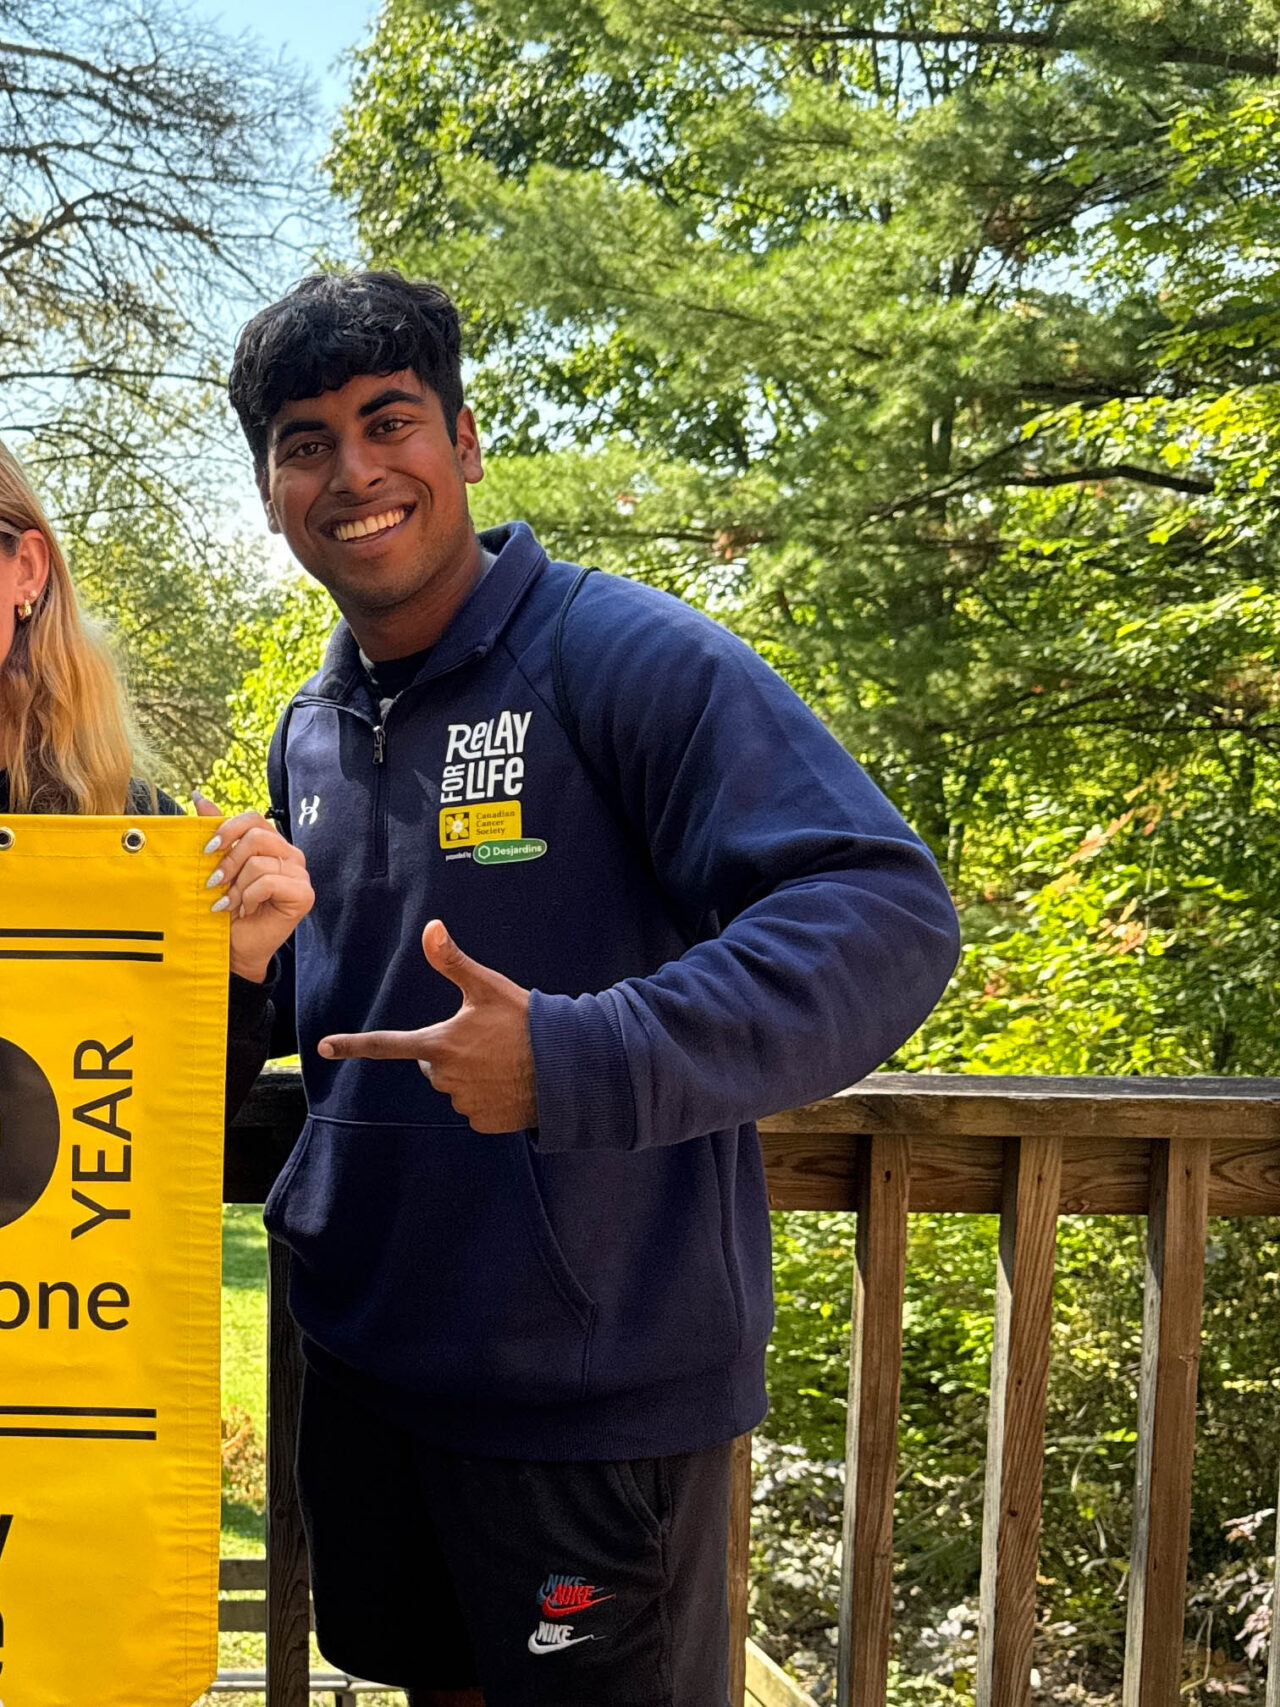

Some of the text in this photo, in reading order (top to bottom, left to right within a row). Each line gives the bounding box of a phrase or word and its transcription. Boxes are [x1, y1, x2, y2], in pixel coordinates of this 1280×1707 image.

[440, 763, 466, 804] FOR
[476, 810, 515, 820] Canadian
[476, 820, 504, 828] Cancer
[476, 827, 506, 836] Society
[493, 844, 543, 857] Desjardins
[70, 1035, 134, 1240] YEAR
[537, 1621, 574, 1643] NIKE
